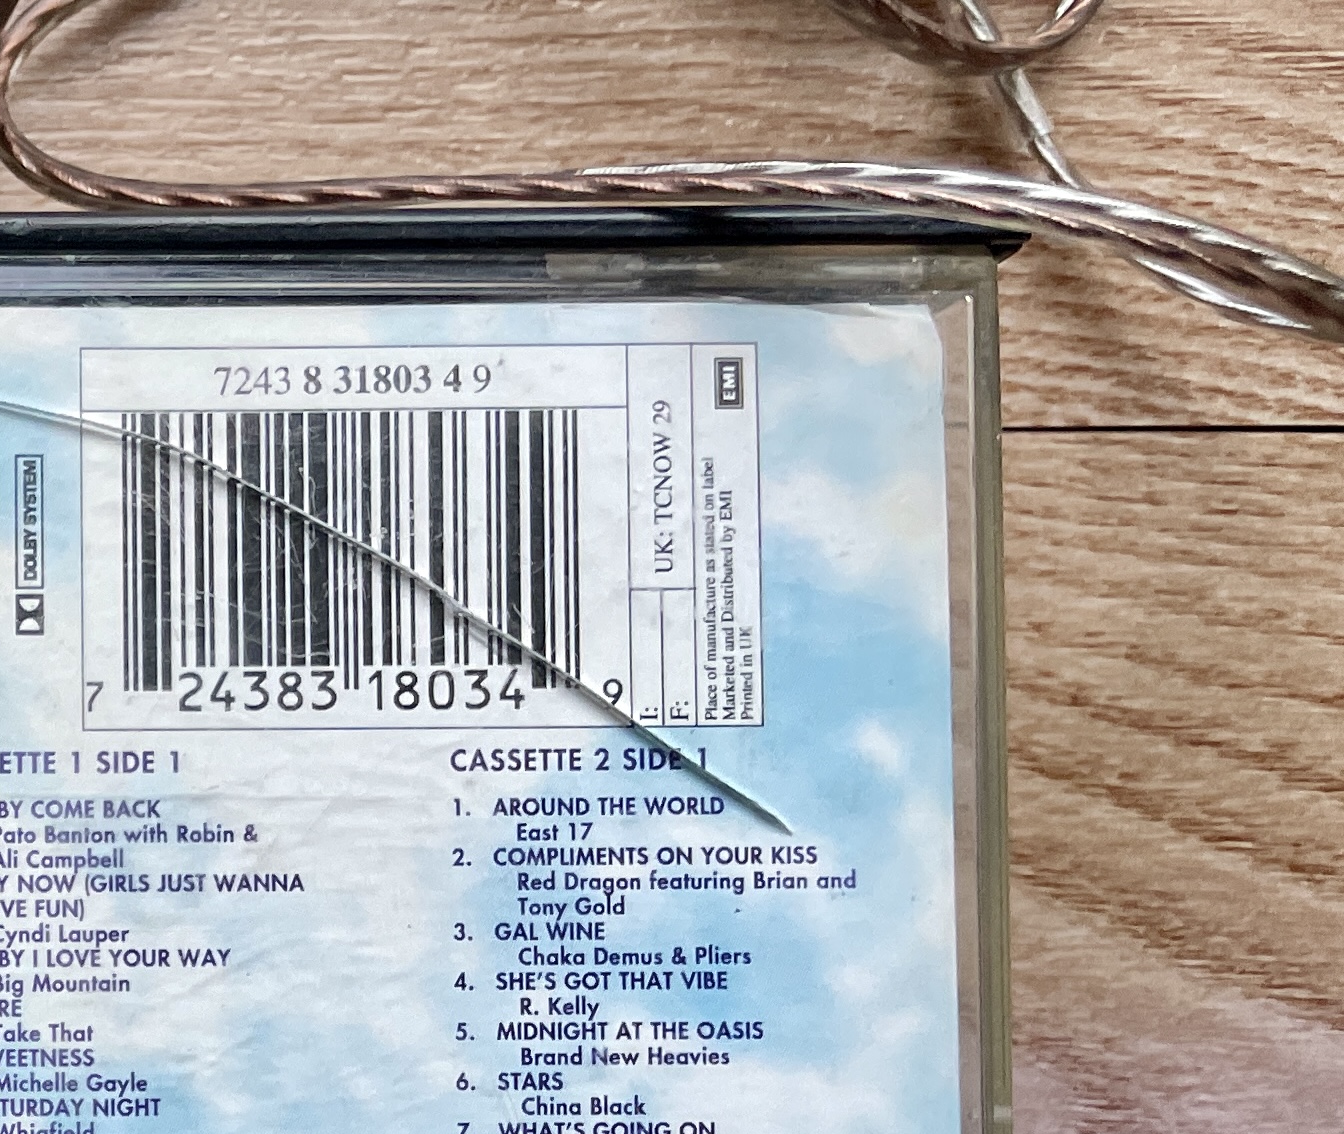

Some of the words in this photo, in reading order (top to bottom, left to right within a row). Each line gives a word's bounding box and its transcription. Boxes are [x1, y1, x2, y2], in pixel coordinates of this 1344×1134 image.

[214, 367, 290, 395] 7243
[304, 366, 321, 394] 8
[333, 365, 431, 394] 31803
[444, 364, 461, 392] 4
[473, 365, 491, 393] 9
[724, 367, 735, 399] EMI
[652, 400, 671, 424] 29
[23, 460, 37, 525] SYSTEM
[653, 433, 672, 524] TCNOW
[24, 528, 37, 580] DOLBY
[655, 533, 673, 573] UK:
[739, 627, 751, 649] UK
[87, 682, 103, 712] 7
[179, 671, 337, 711] 24383
[369, 669, 525, 710] 18034
[603, 679, 623, 705] 9
[740, 672, 753, 719] Printed
[71, 751, 80, 774] 1
[97, 751, 154, 774] SIDE
[169, 750, 179, 774] 1
[451, 749, 581, 771] CASSETTE
[595, 748, 609, 770] 2
[622, 749, 682, 772] SIDE
[698, 748, 708, 773] 1
[521, 1045, 582, 1065] Brand
[592, 1048, 639, 1065] New
[648, 1047, 729, 1065] Heavies
[93, 1098, 161, 1117] NIGHT
